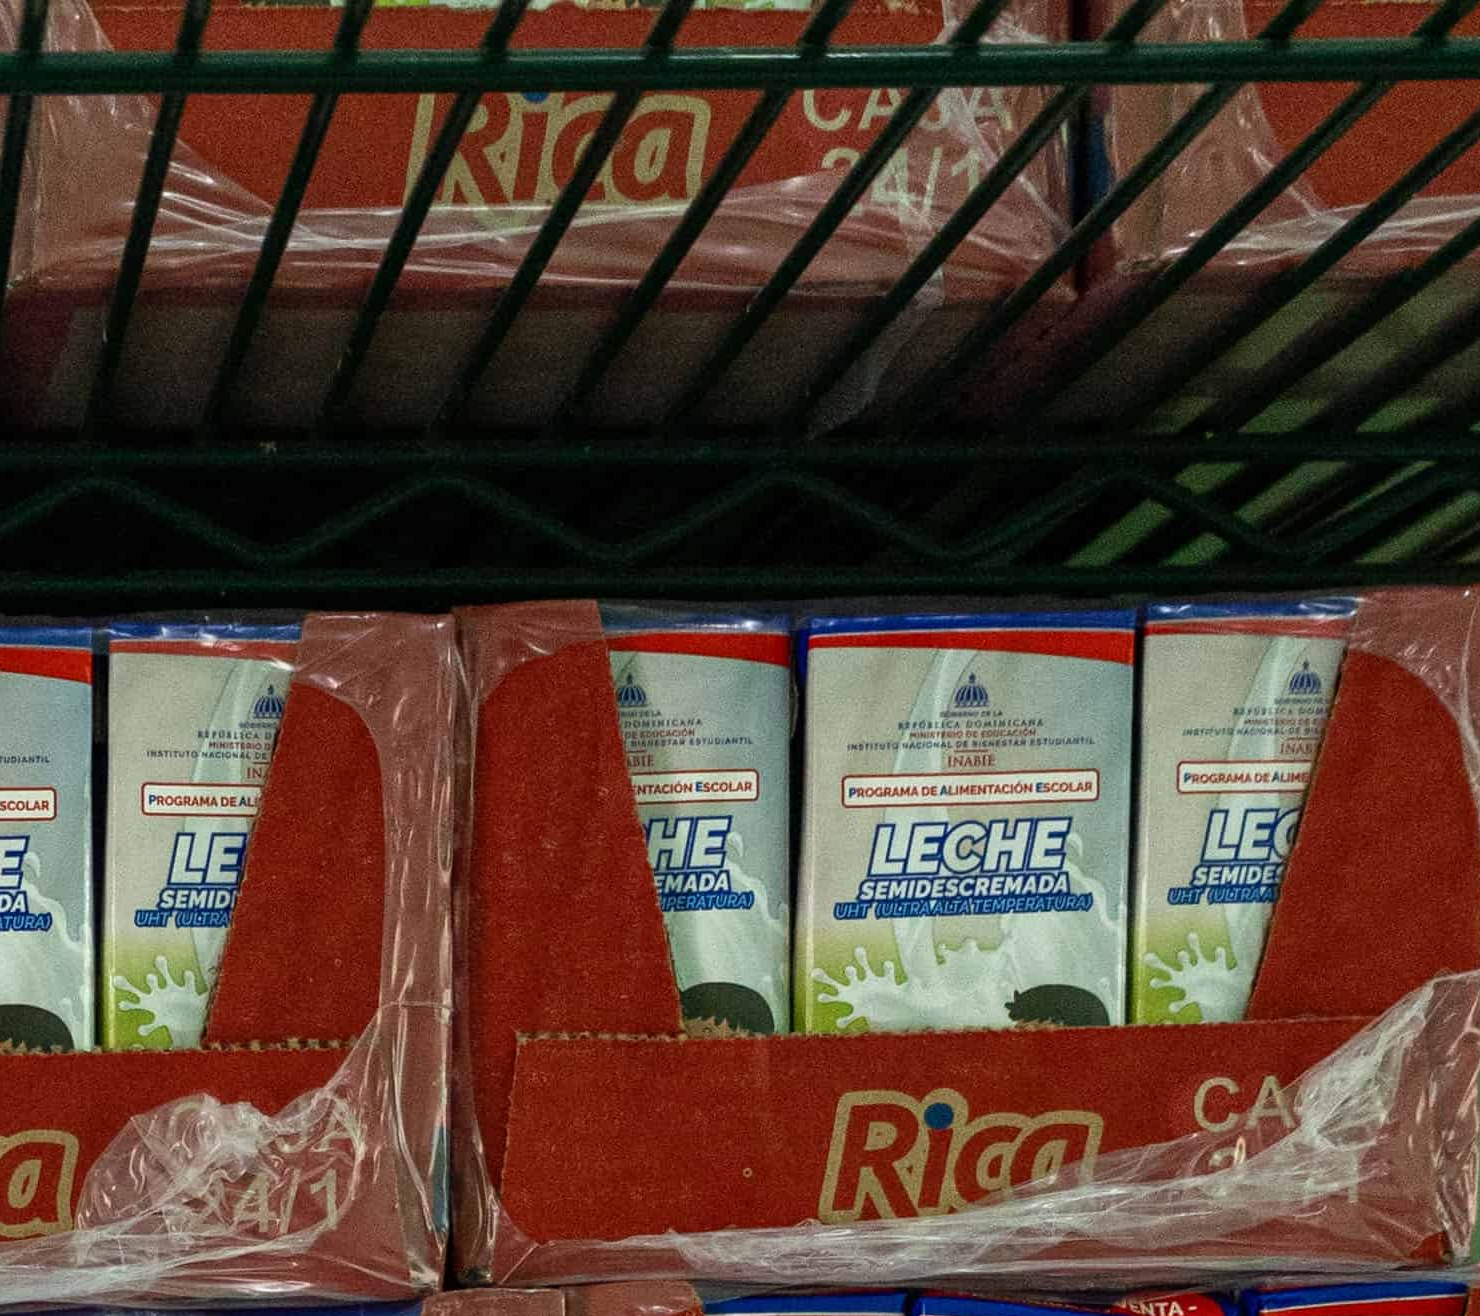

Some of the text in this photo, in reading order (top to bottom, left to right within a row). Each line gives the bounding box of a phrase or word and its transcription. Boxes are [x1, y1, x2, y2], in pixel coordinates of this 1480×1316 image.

[947, 755, 996, 767] INABIE
[848, 781, 1093, 799] PROGRAMA DE ALIMENTACIÓN ESCOLAR
[868, 819, 1071, 875] LECHE
[858, 874, 1070, 900] SEMIDESCREMADA
[819, 1088, 1104, 1226] Rica
